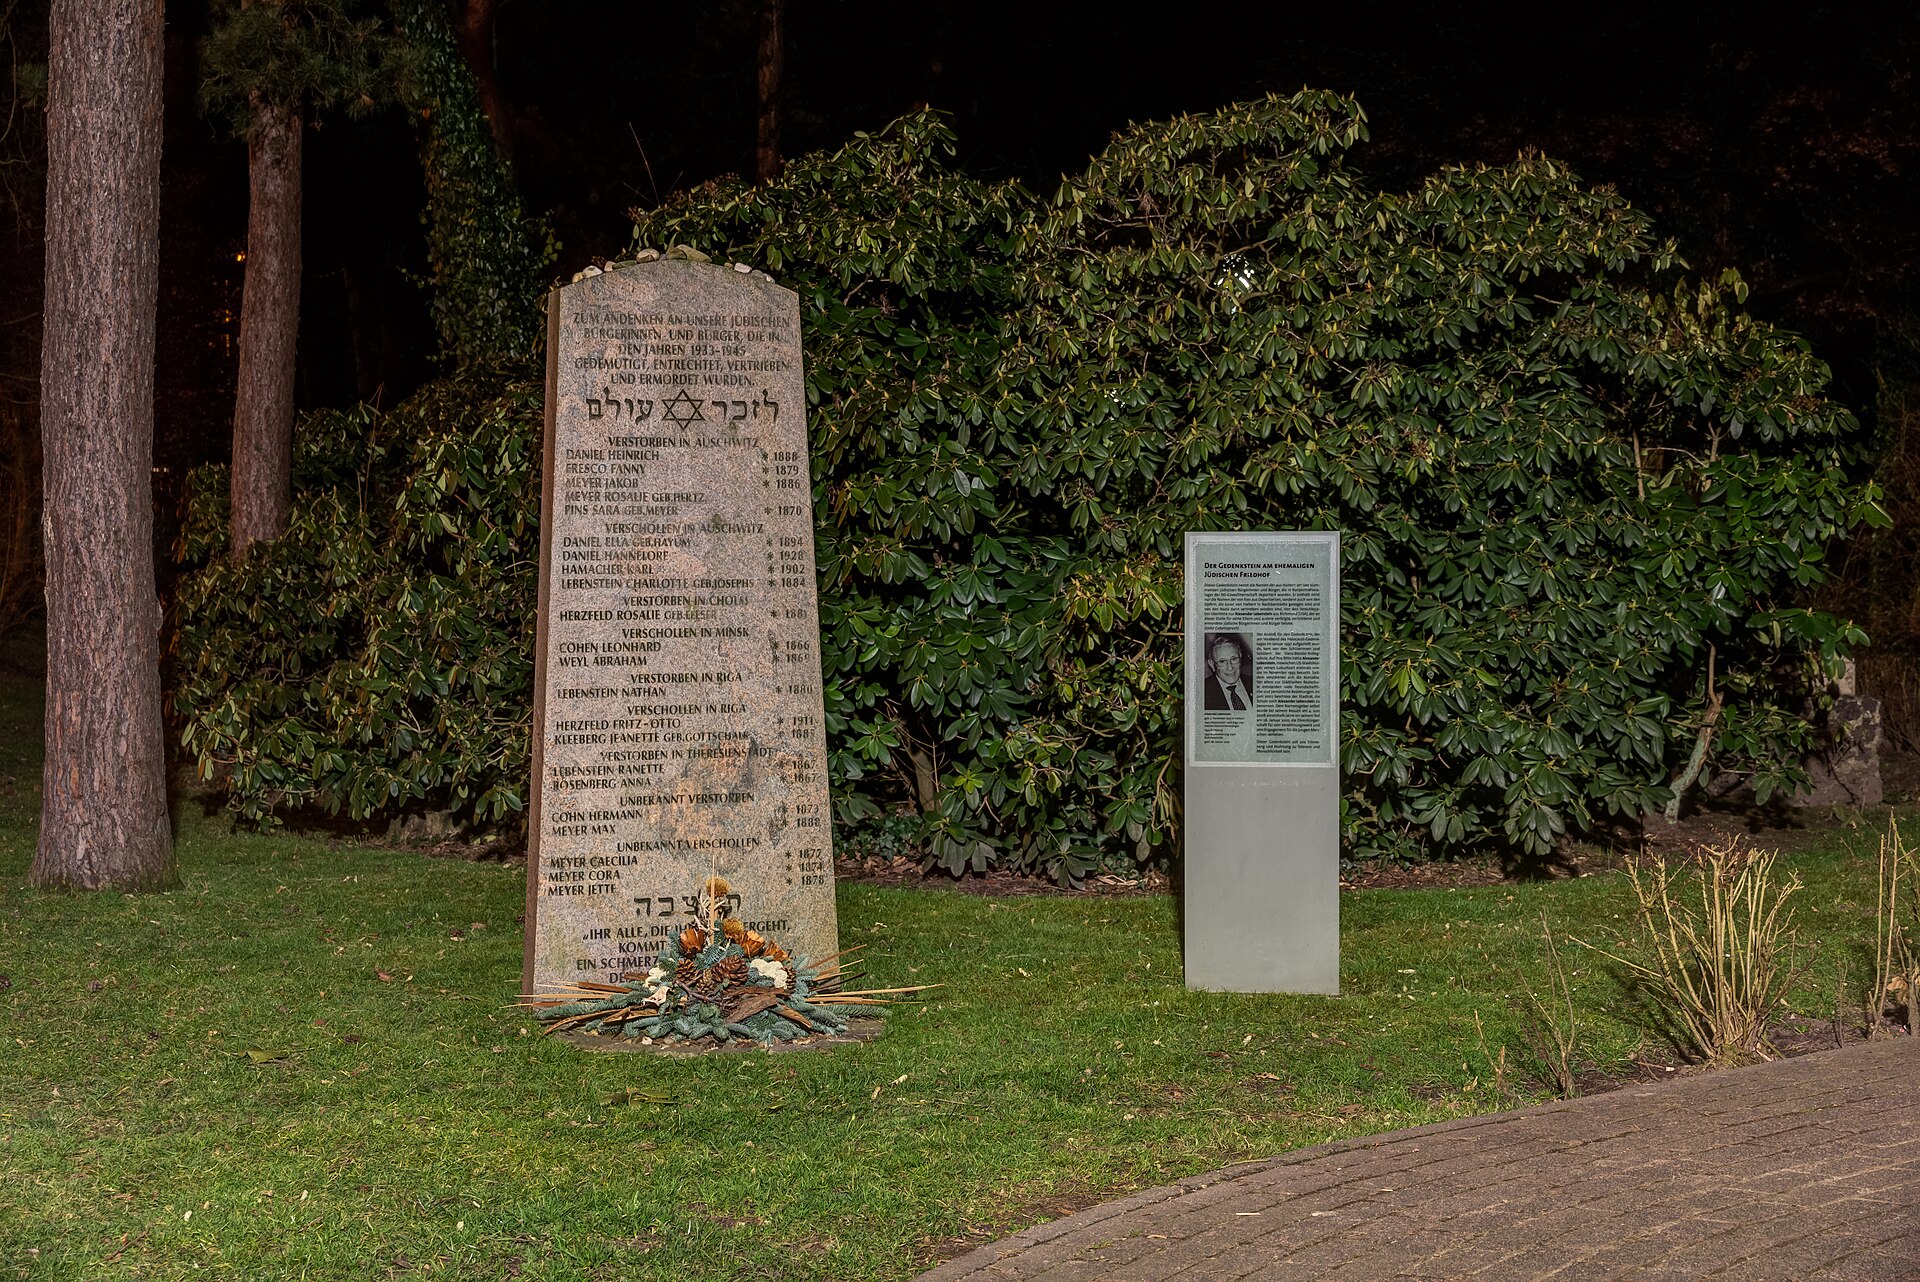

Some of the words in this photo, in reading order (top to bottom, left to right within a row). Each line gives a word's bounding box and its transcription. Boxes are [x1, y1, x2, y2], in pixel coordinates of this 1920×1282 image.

[574, 313, 599, 324] ZUM
[604, 314, 664, 325] ANDENKEN
[668, 315, 682, 325] AN
[687, 315, 727, 326] UNSERE
[669, 329, 694, 341] UND
[747, 331, 766, 342] DIE
[769, 332, 781, 342] IN
[619, 344, 641, 354] DEN
[642, 344, 686, 357] JAHREN
[691, 345, 746, 356] 1933-1945
[654, 359, 723, 373] ENTRECHTET,
[727, 360, 789, 371] VERTRIEBEN
[611, 373, 636, 384] UND
[640, 374, 700, 385] ERMORDET
[703, 374, 755, 386] WURDEN.
[586, 387, 654, 425] עולם
[608, 436, 676, 447] VERSTORBEN
[680, 437, 691, 447] IN
[694, 438, 759, 448] AUSCHWITZ
[566, 449, 605, 460] DANIEL
[608, 450, 659, 461] HEINRICH
[566, 463, 606, 473] FRESCO
[611, 464, 646, 474] FANNY
[775, 465, 799, 475] 1879
[565, 477, 602, 488] MEYER
[604, 479, 639, 490] JAKOB
[776, 479, 801, 489] 1886
[564, 491, 601, 501] MEYER
[604, 492, 648, 502] ROSALIE
[564, 505, 589, 515] PINS
[592, 505, 620, 515] SARA
[778, 505, 802, 516] 1870
[605, 523, 680, 534] VERSCHOLLEN
[683, 523, 695, 534] IN
[700, 523, 764, 534] AUSCHWITZ
[563, 537, 602, 547] DANIEL
[605, 537, 629, 547] ELLA
[780, 537, 804, 547] 1894
[563, 551, 601, 561] DANIEL
[604, 551, 669, 561] HANNELORE
[780, 550, 804, 560] 1928
[562, 564, 623, 575] HAMACHER
[627, 564, 653, 575] KARL
[781, 564, 805, 574] 1902
[561, 578, 622, 589] LEBENSTEIN
[626, 579, 689, 589] CHARLOTTE
[623, 595, 691, 606] VERSTORBEN
[694, 595, 705, 606] IN
[560, 610, 613, 621] HERZFELD
[617, 610, 660, 621] ROSALIE
[622, 628, 697, 639] VERSCHOLLEN
[700, 628, 712, 637] IN
[716, 627, 749, 637] MINSK
[560, 642, 598, 653] COHEN
[602, 641, 661, 653] LEONHARD
[786, 641, 810, 651] 1866
[560, 656, 589, 667] WEYL
[593, 656, 647, 666] ABRAHAM
[631, 673, 698, 684] VERSTORBEN
[701, 673, 712, 682] IN
[716, 672, 742, 683] RIGA
[557, 688, 618, 699] LEBENSTEIN
[622, 687, 667, 698] NATHAN
[627, 704, 701, 716] VERSCHOLLEN
[705, 704, 716, 714] IN
[720, 703, 746, 714] RIGA
[556, 720, 609, 731] HERZFELD
[555, 734, 606, 745] KLEEBERG
[610, 733, 659, 744] JEANETTE
[600, 750, 667, 761] VERSTORBEN
[671, 750, 682, 759] IN
[687, 747, 773, 759] THERESIENSTADT
[553, 765, 614, 777] LEBENSTEIN
[618, 764, 664, 775] RANETTE
[553, 779, 616, 791] ROSENBERG
[620, 778, 651, 788] ANNA
[620, 795, 685, 807] UNBEKANNT
[688, 792, 754, 804] VERSTORBEN
[552, 811, 585, 822] COHN
[589, 810, 643, 821] HERMANN
[552, 826, 587, 837] MEYER
[591, 825, 616, 835] MAX
[617, 840, 682, 852] UNBEKANNT
[685, 838, 760, 849] VERSCHOLLEN
[550, 857, 586, 869] MEYER
[590, 855, 638, 867] CAECILIA
[548, 871, 584, 882] MEYER
[588, 870, 620, 881] CORA
[548, 885, 584, 896] MEYER
[588, 884, 616, 896] JETTE
[801, 875, 824, 886] 1878
[616, 927, 648, 939] ALLE,
[651, 926, 670, 937] DIE
[619, 940, 666, 954] KOMMT
[577, 959, 597, 970] EIN
